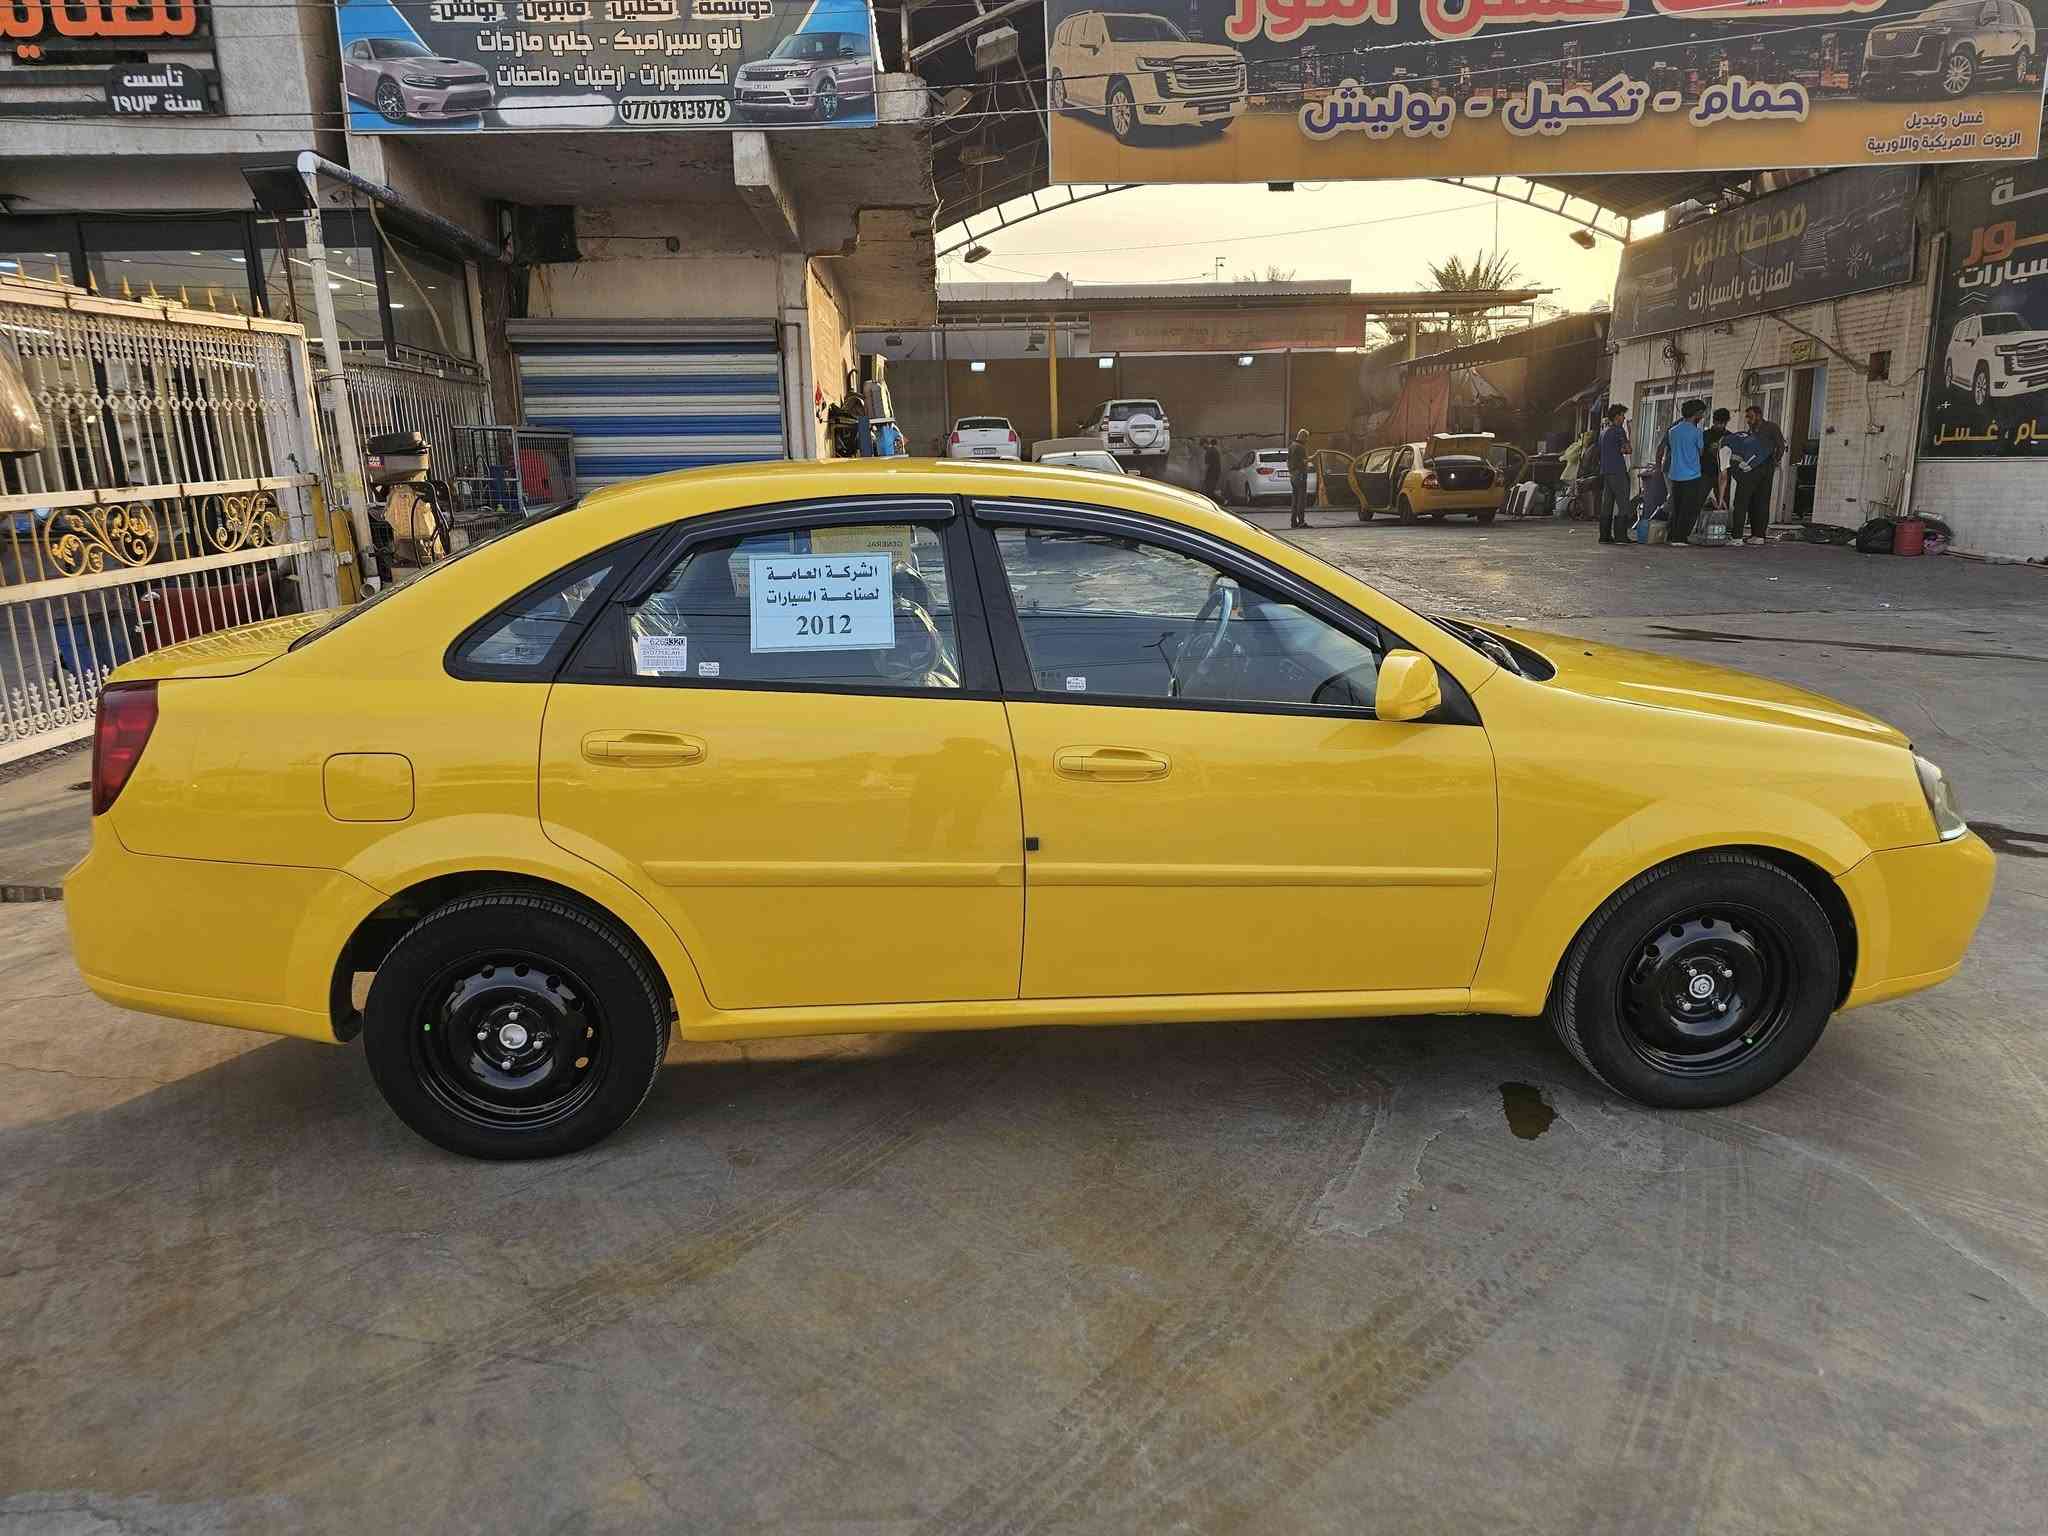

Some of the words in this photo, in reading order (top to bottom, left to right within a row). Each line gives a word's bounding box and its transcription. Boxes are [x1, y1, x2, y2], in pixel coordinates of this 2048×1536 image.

[476, 30, 544, 57] مازدات
[549, 30, 594, 56] جلي
[613, 28, 702, 56] سيراميك
[706, 27, 742, 56] نانو
[496, 65, 560, 87] ملصقات
[574, 64, 625, 91] ارضيات
[640, 63, 729, 91] اكسسوارات
[164, 93, 203, 112] سنة
[621, 100, 727, 120] 07707813878
[1302, 82, 1454, 136] بوليش
[1507, 78, 1647, 132] تكحيل
[1692, 79, 1806, 123] حمام
[1906, 113, 1948, 130] وتبديل
[1952, 111, 1984, 127] غسل
[1922, 134, 1975, 152] الامريكية
[1983, 132, 2021, 149] الزيوت
[1687, 276, 1745, 313] بالسيارات
[1935, 419, 1998, 446] غسل
[767, 566, 822, 580] العامة
[826, 562, 878, 581] الشركة
[766, 590, 817, 606] السيارات
[820, 587, 879, 601] لصناعة
[796, 614, 852, 635] 2012
